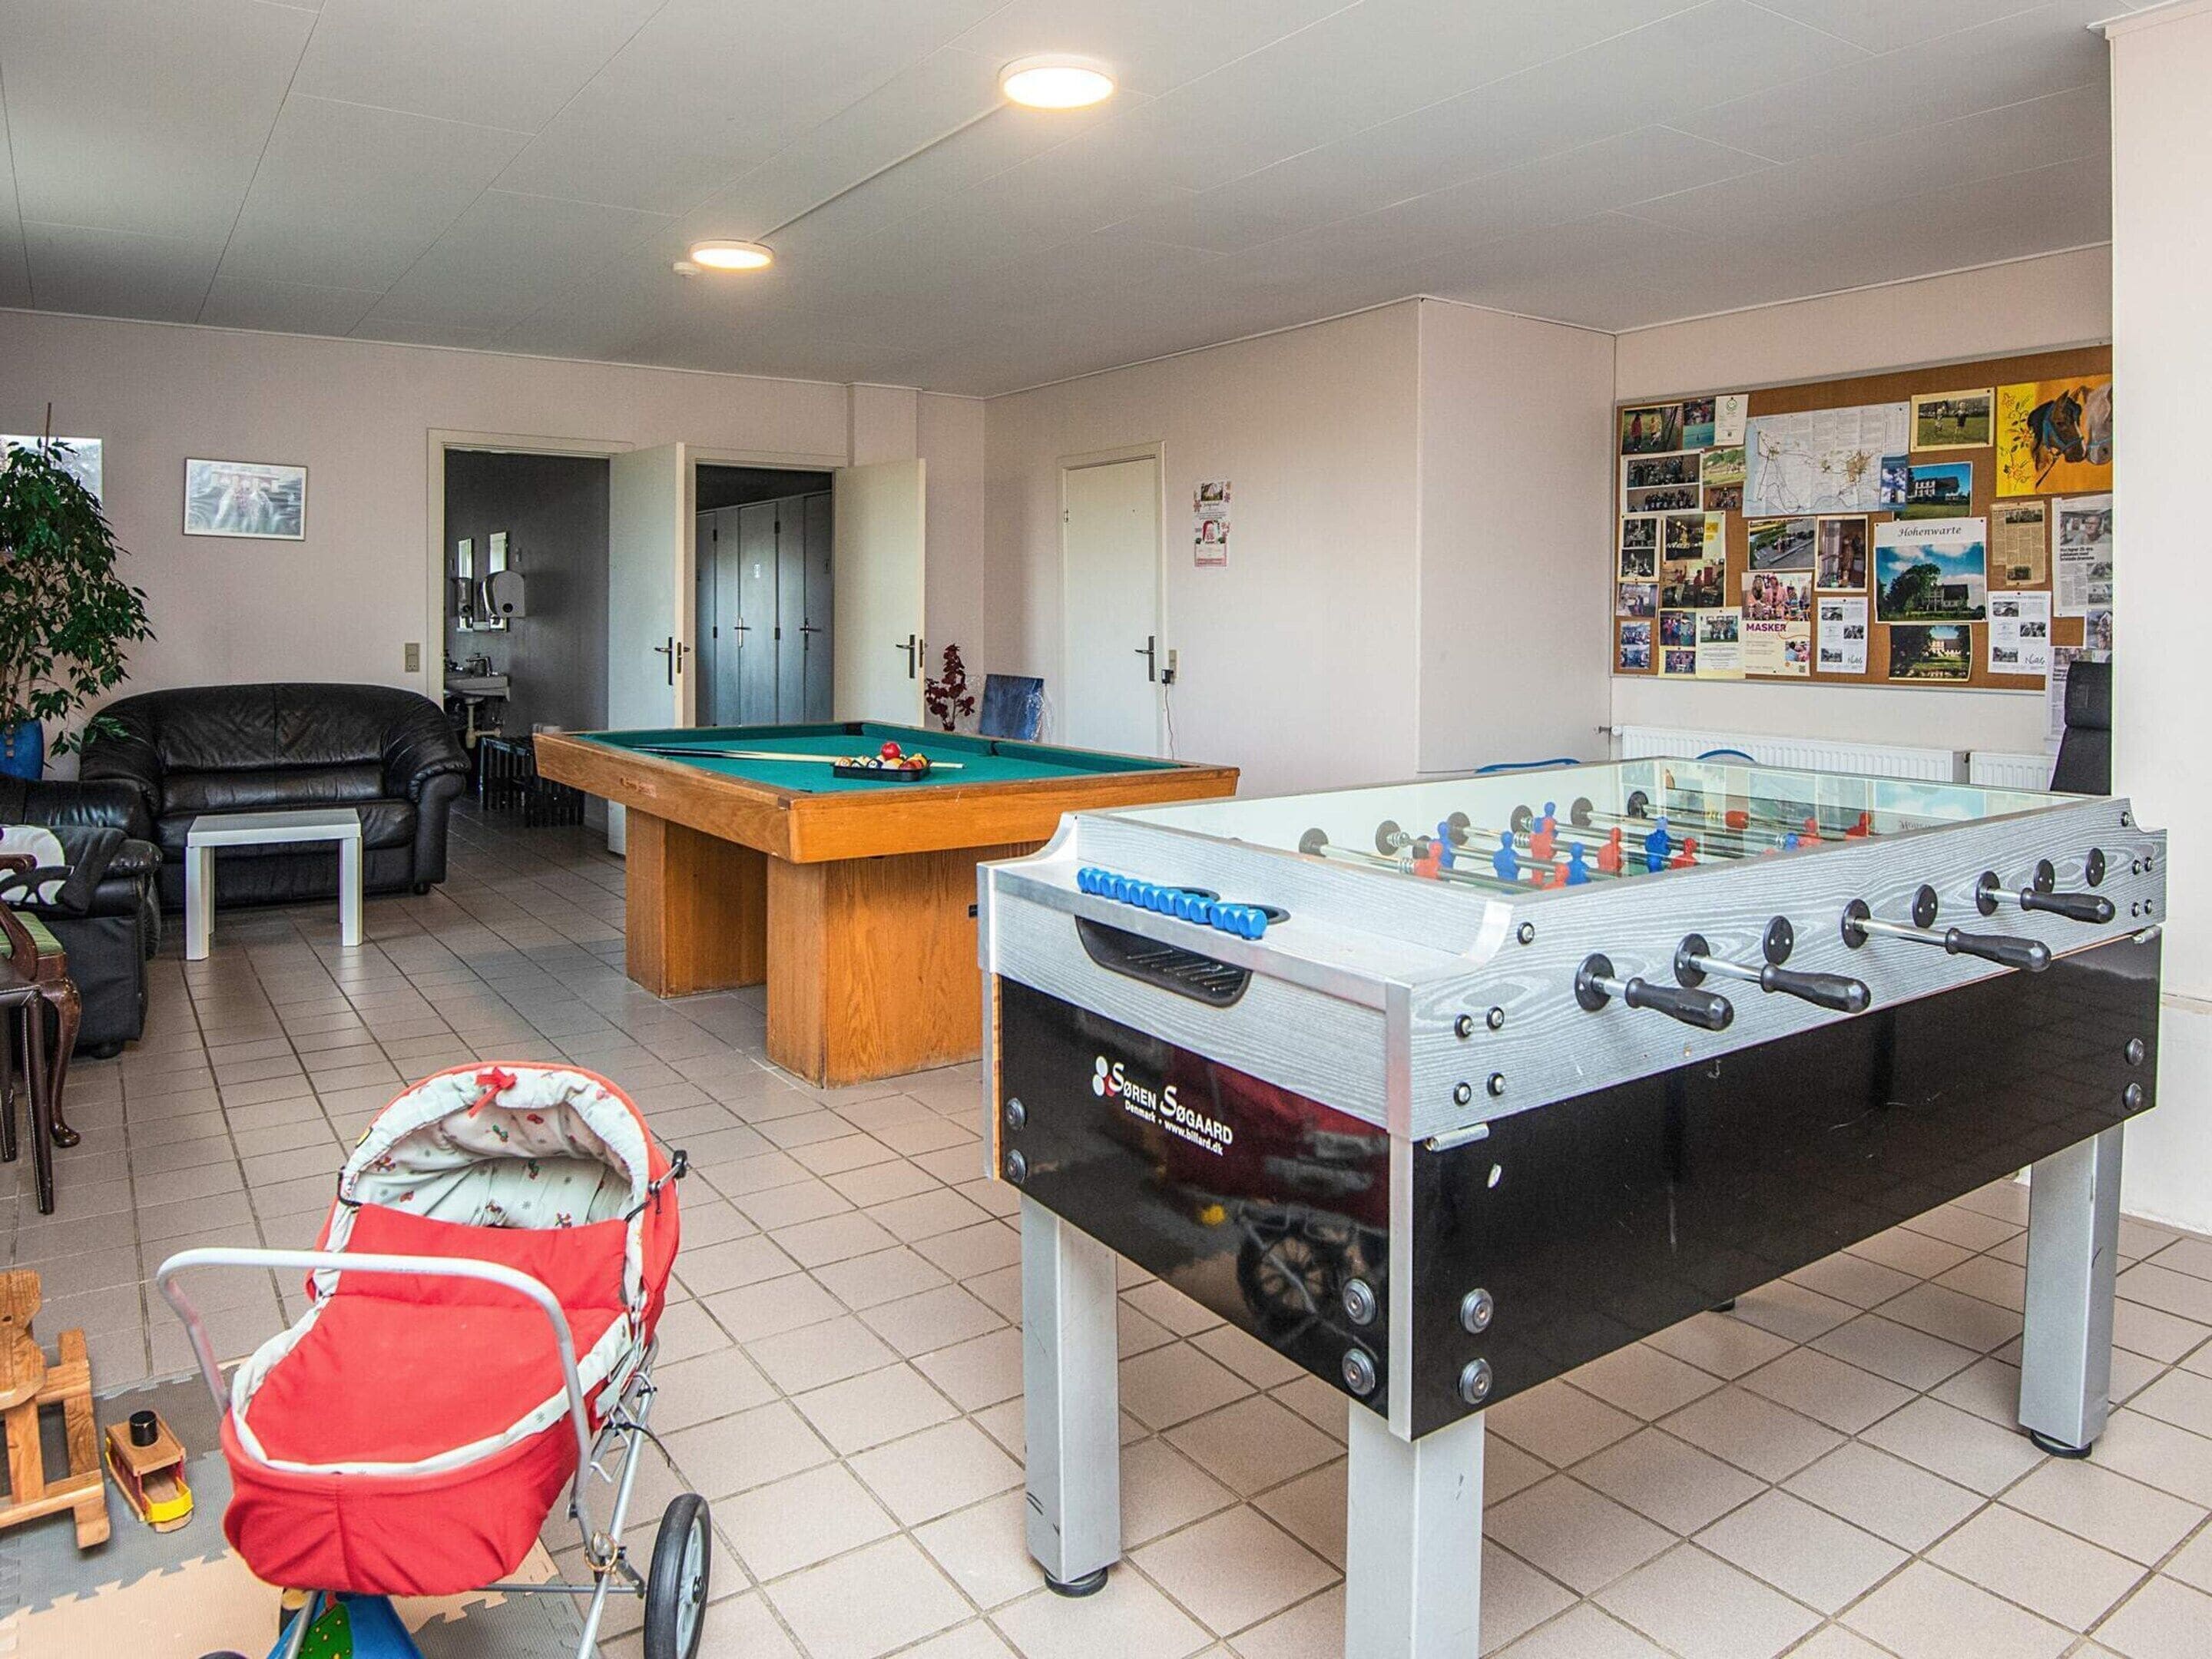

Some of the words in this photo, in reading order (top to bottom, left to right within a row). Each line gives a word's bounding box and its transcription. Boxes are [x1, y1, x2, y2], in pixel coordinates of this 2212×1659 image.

[1898, 526, 1962, 538] Hohenwarte
[1746, 622, 1786, 632] MASKER
[1108, 1062, 1157, 1111] SØREN
[1160, 1085, 1233, 1145] SØGAARD
[1124, 1100, 1157, 1124] Denmark
[1164, 1120, 1224, 1157] www.billard.dk
